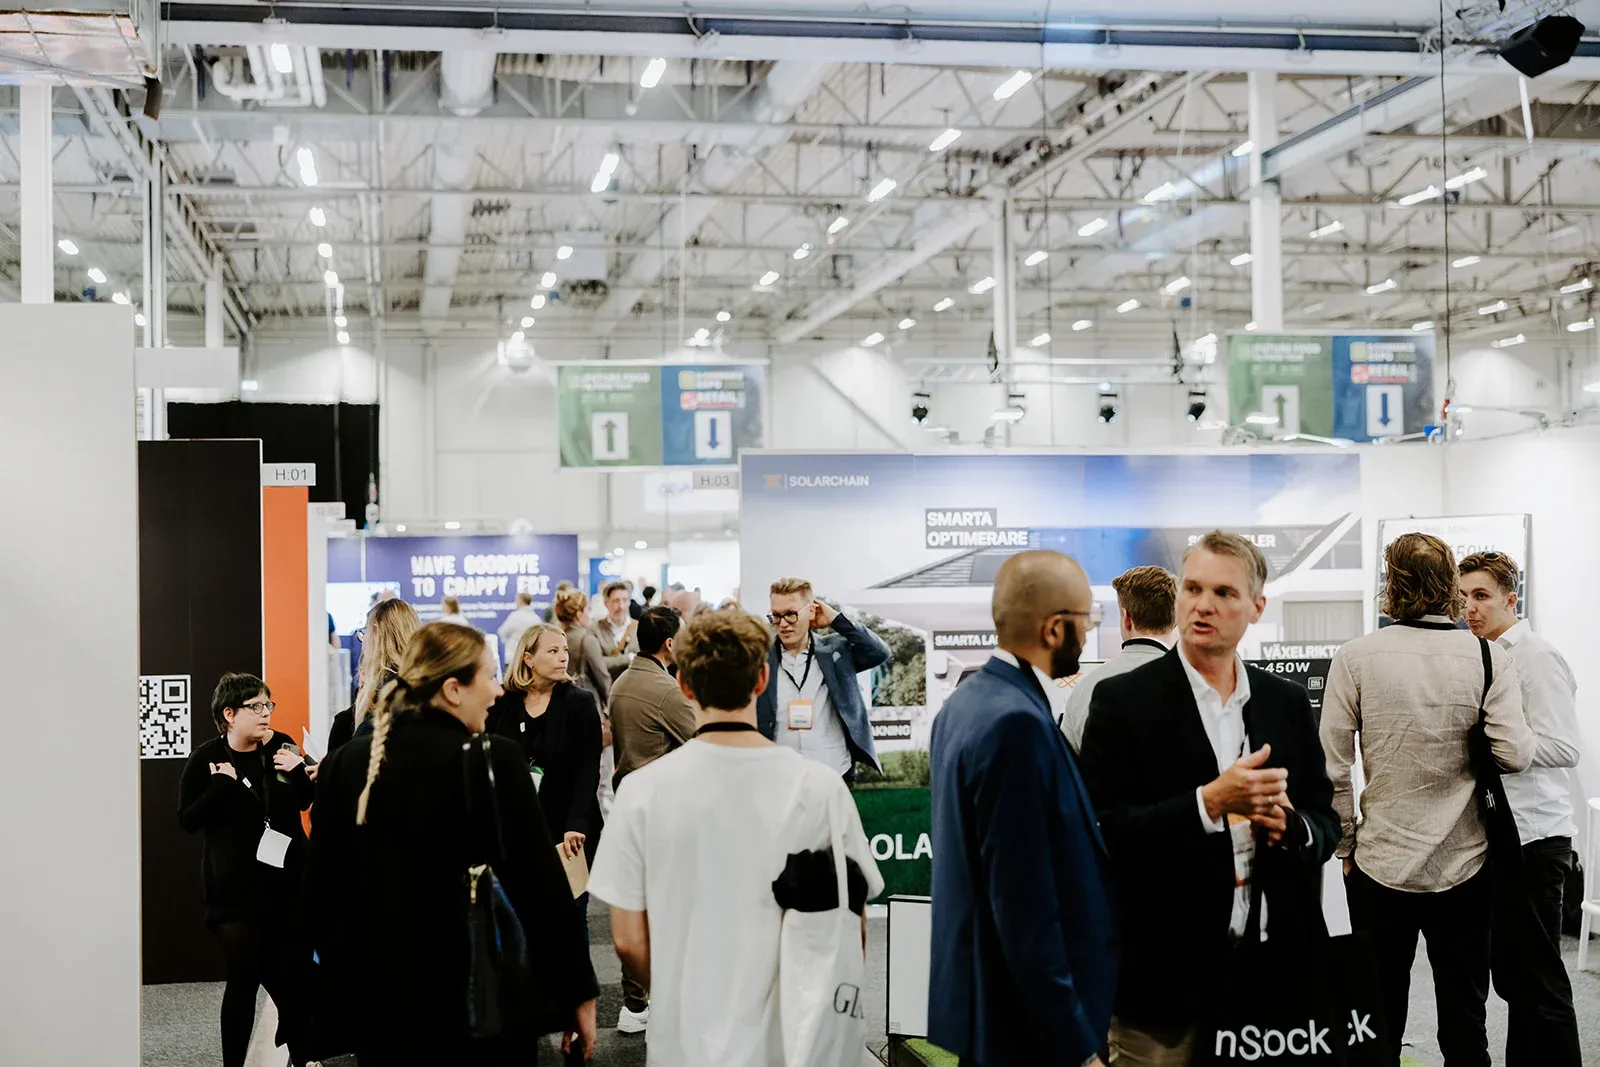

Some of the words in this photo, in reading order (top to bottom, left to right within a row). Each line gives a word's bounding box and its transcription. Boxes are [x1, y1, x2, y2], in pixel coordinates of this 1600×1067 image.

[275, 468, 307, 481] H:01
[700, 475, 730, 487] H:03
[788, 475, 870, 487] SOLARCHAIN
[927, 511, 994, 527] SMARTA
[927, 531, 1029, 546] OPTIMERARE
[411, 577, 436, 597] TO
[443, 576, 509, 597] CRAPPY
[935, 634, 981, 647] SMARTA
[1215, 1019, 1332, 1061] nSock
